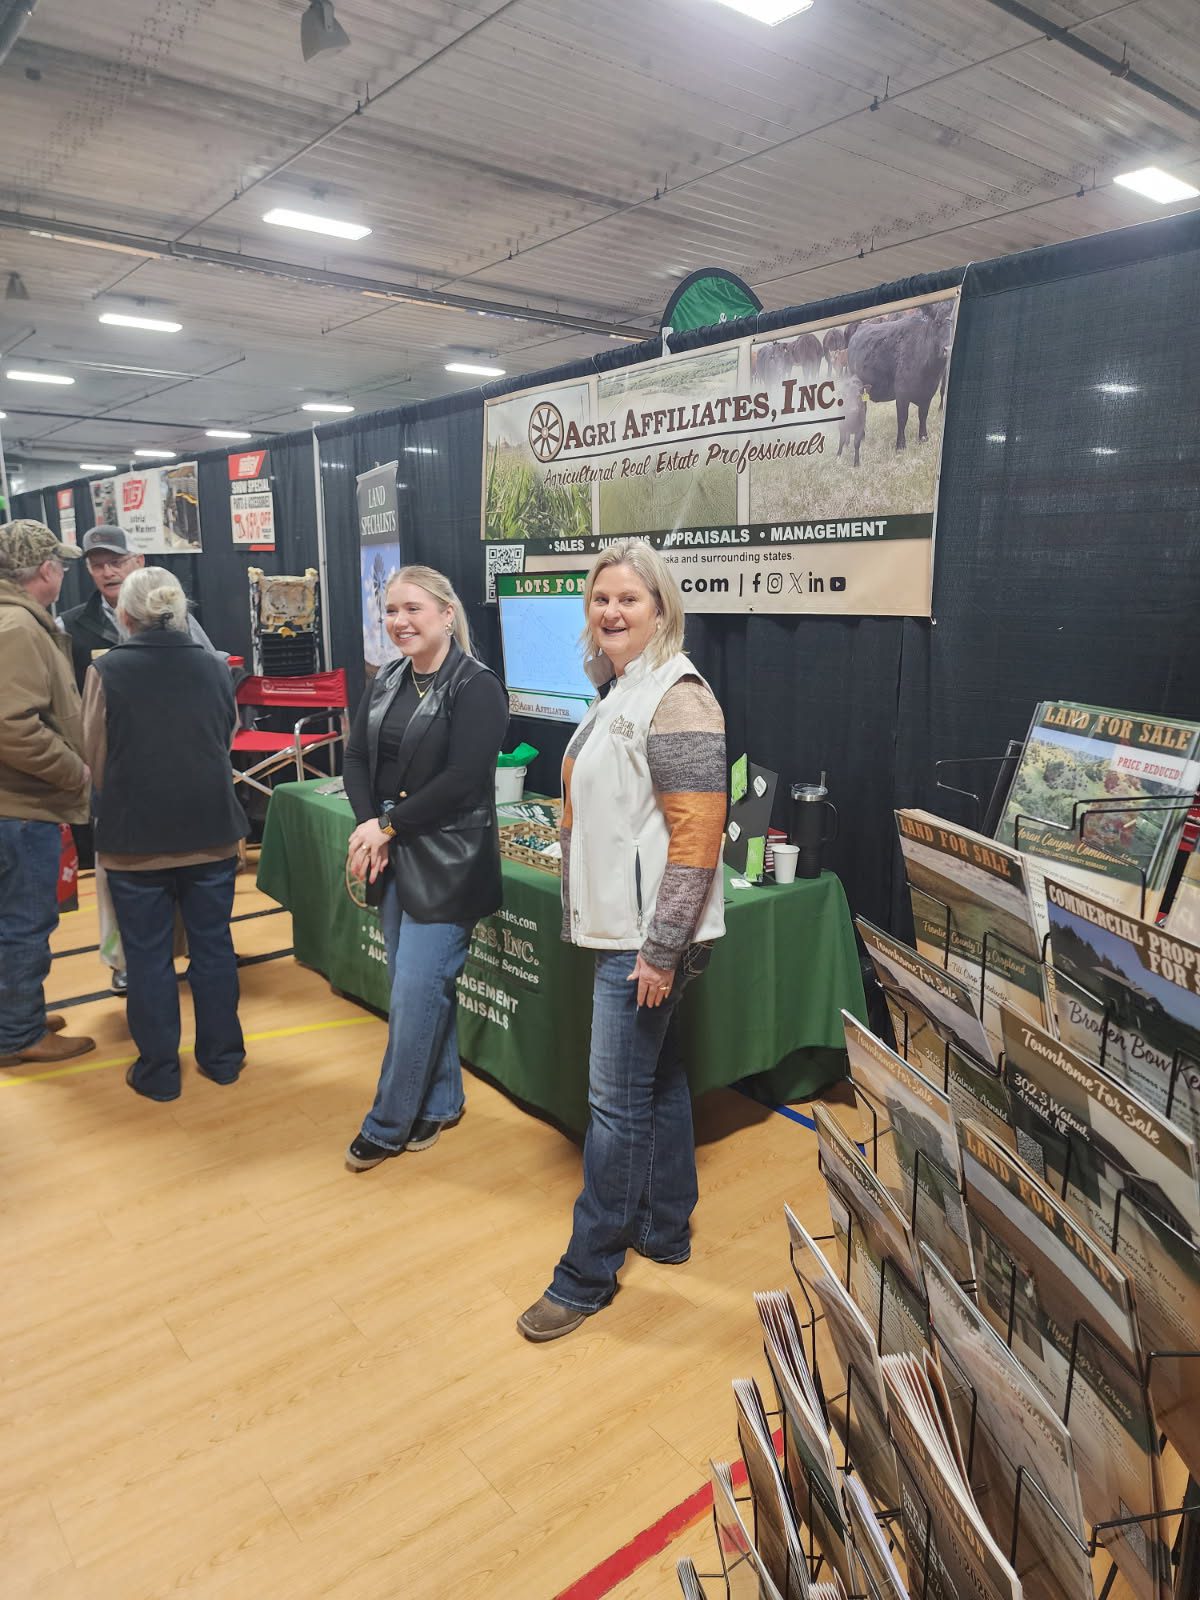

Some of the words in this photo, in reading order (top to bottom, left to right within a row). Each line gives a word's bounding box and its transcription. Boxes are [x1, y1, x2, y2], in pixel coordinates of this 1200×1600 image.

[563, 420, 617, 450] AGRI
[622, 391, 777, 441] AFFILIATES,
[781, 379, 845, 414] INC.
[543, 460, 618, 490] Agricultural
[621, 454, 651, 478] Real
[656, 449, 700, 473] Estate
[705, 432, 826, 474] Professionals
[368, 485, 386, 509] LAND
[361, 510, 396, 536] SPECIALISTS
[554, 539, 585, 552] SALES
[663, 528, 750, 547] APPRAISALS
[770, 520, 888, 541] MANAGEMENT
[681, 553, 698, 563] and
[701, 551, 760, 564] surrounding
[763, 551, 795, 562] states.
[1043, 706, 1091, 730] LAND
[1094, 715, 1134, 740] FOR
[1138, 723, 1193, 751] SALE
[1117, 756, 1142, 771] PRICE
[898, 816, 934, 842] LAND
[940, 830, 969, 857] FOR
[972, 844, 1011, 878] SALE
[1048, 884, 1144, 947] COMMERCIAL
[501, 927, 540, 967] INC.
[501, 957, 540, 985] Services
[1147, 950, 1189, 989] FOR
[456, 990, 510, 1031] RAISALS
[1068, 1000, 1126, 1051] Broen
[1129, 1033, 1173, 1073] Bow
[1013, 1072, 1038, 1100] 302
[1049, 1098, 1091, 1142] Walnut,
[1021, 1027, 1096, 1092] Townhome
[1094, 1079, 1123, 1116] For
[1123, 1104, 1161, 1145] Sale
[965, 1128, 1010, 1183] LAND
[1017, 1176, 1056, 1229] FOR
[1063, 1221, 1113, 1292] SALE
